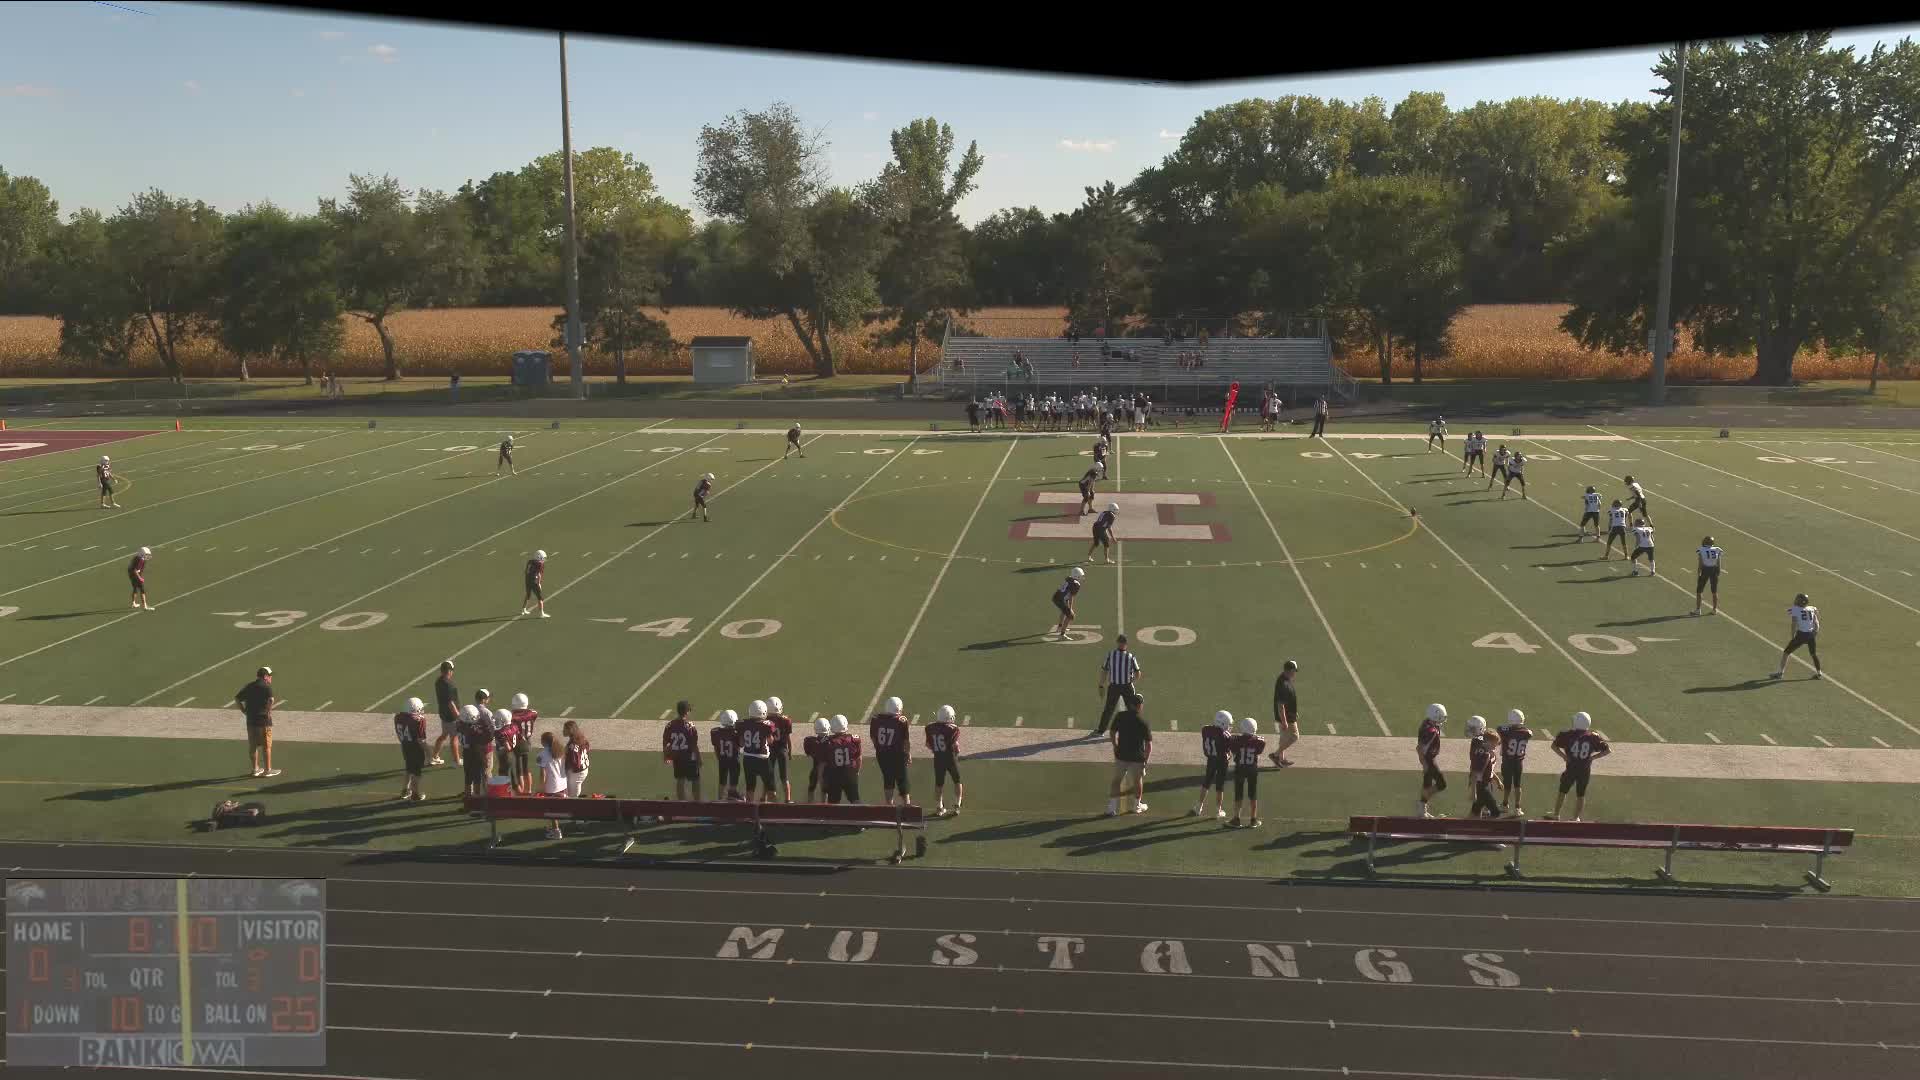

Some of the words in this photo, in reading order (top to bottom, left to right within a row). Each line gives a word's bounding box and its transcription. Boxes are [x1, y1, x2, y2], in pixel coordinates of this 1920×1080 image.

[670, 732, 688, 751] 22
[743, 730, 760, 750] 94
[877, 727, 895, 746] 67
[932, 734, 946, 752] 16
[834, 746, 852, 767] 61
[1240, 748, 1255, 765] 15
[1570, 740, 1590, 760] 48
